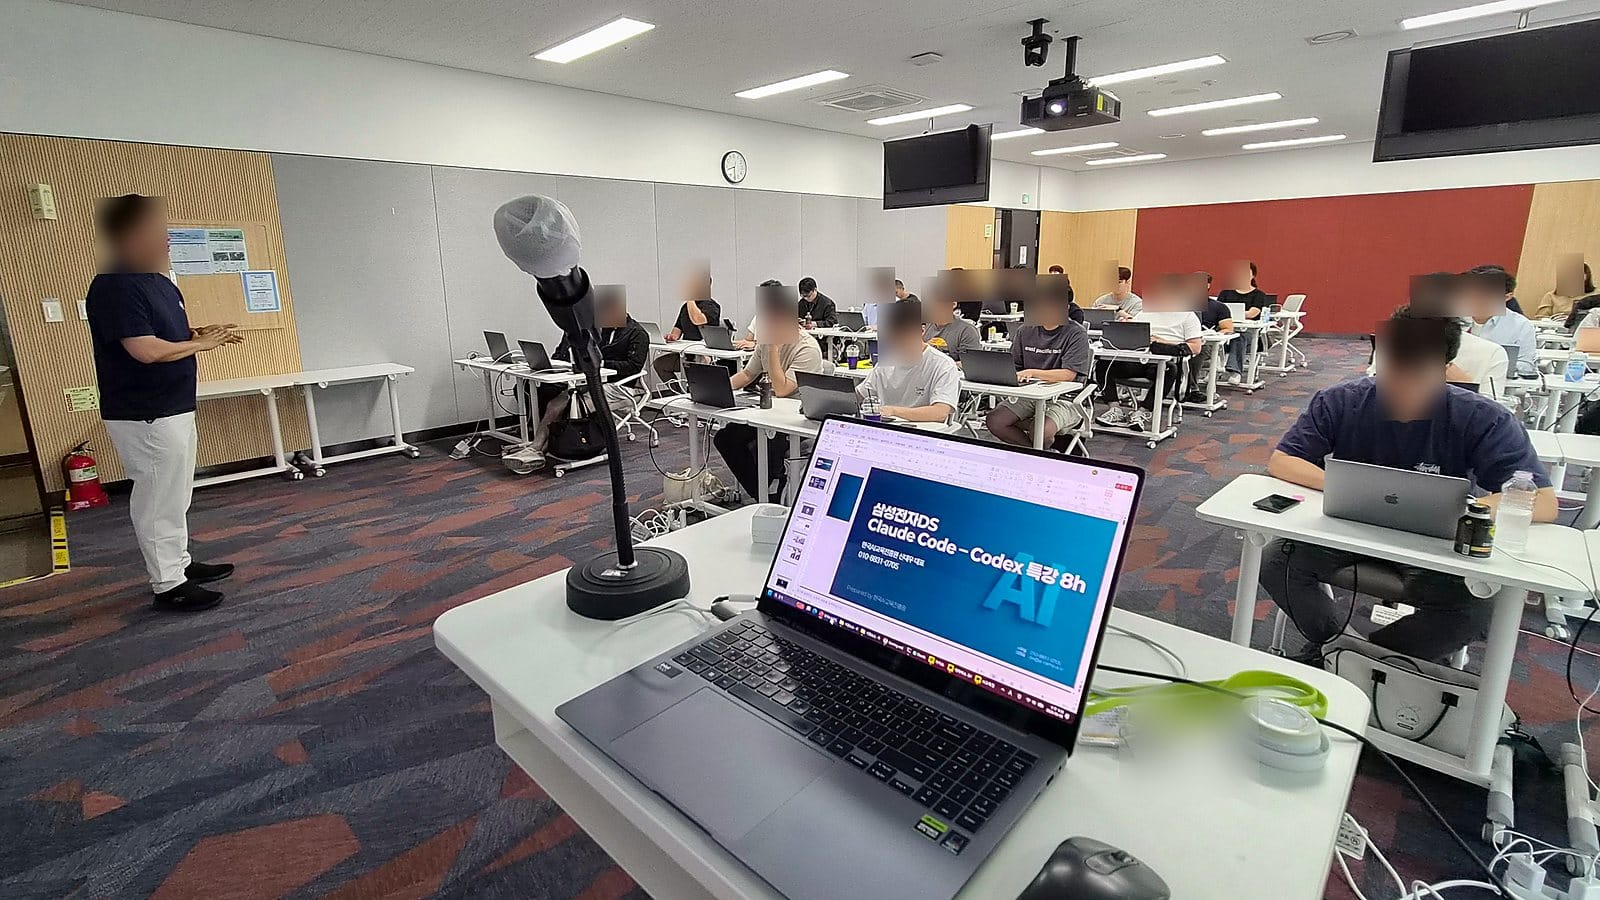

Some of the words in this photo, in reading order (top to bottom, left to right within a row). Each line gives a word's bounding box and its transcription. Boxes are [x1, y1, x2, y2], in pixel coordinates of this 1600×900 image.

[871, 502, 940, 532] 삼성전자DS
[867, 518, 916, 543] Claude
[917, 532, 957, 555] Code
[970, 547, 1024, 576] Codex
[1026, 561, 1060, 585] 특강
[1059, 572, 1087, 594] 8h
[983, 552, 1066, 627] AI
